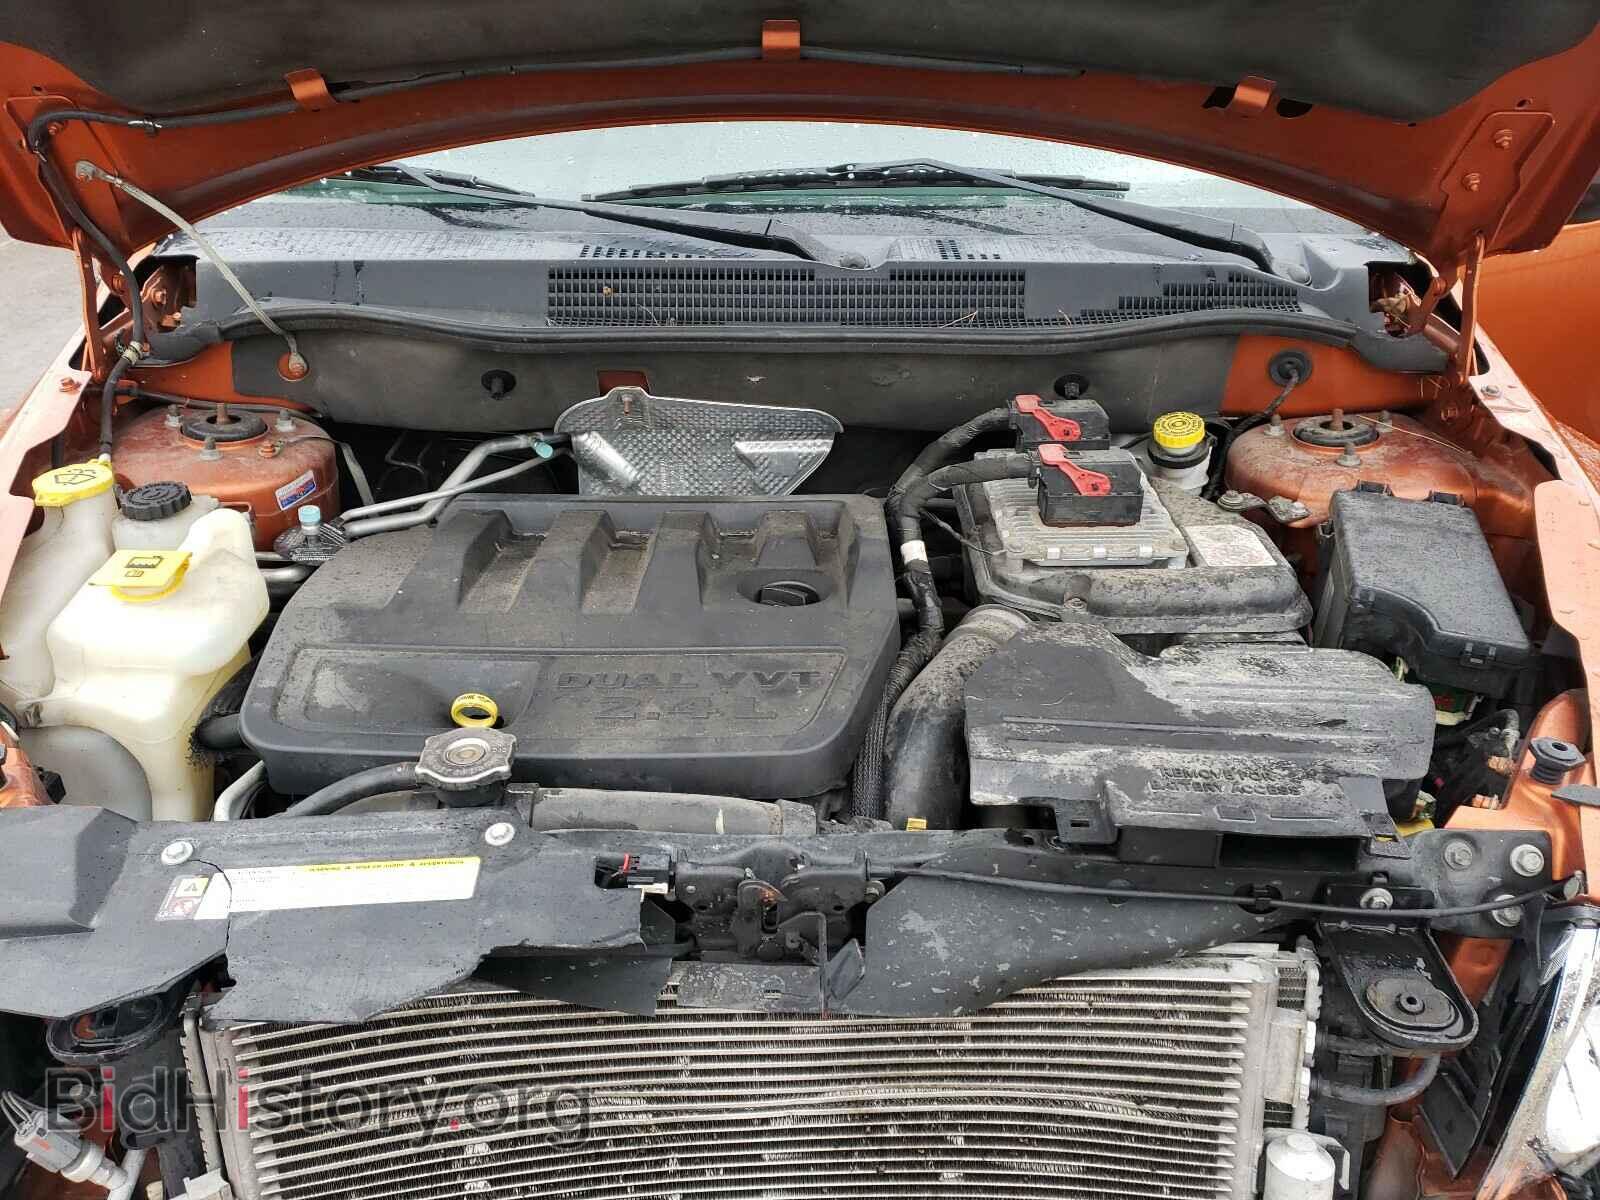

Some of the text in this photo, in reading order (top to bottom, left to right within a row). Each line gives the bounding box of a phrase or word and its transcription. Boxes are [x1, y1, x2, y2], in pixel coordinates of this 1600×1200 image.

[558, 671, 822, 689] DUAL VVT
[593, 696, 777, 720] 2.4L
[1159, 767, 1276, 782] REMOVE FOR
[1147, 778, 1305, 797] BATTERY ACCESS
